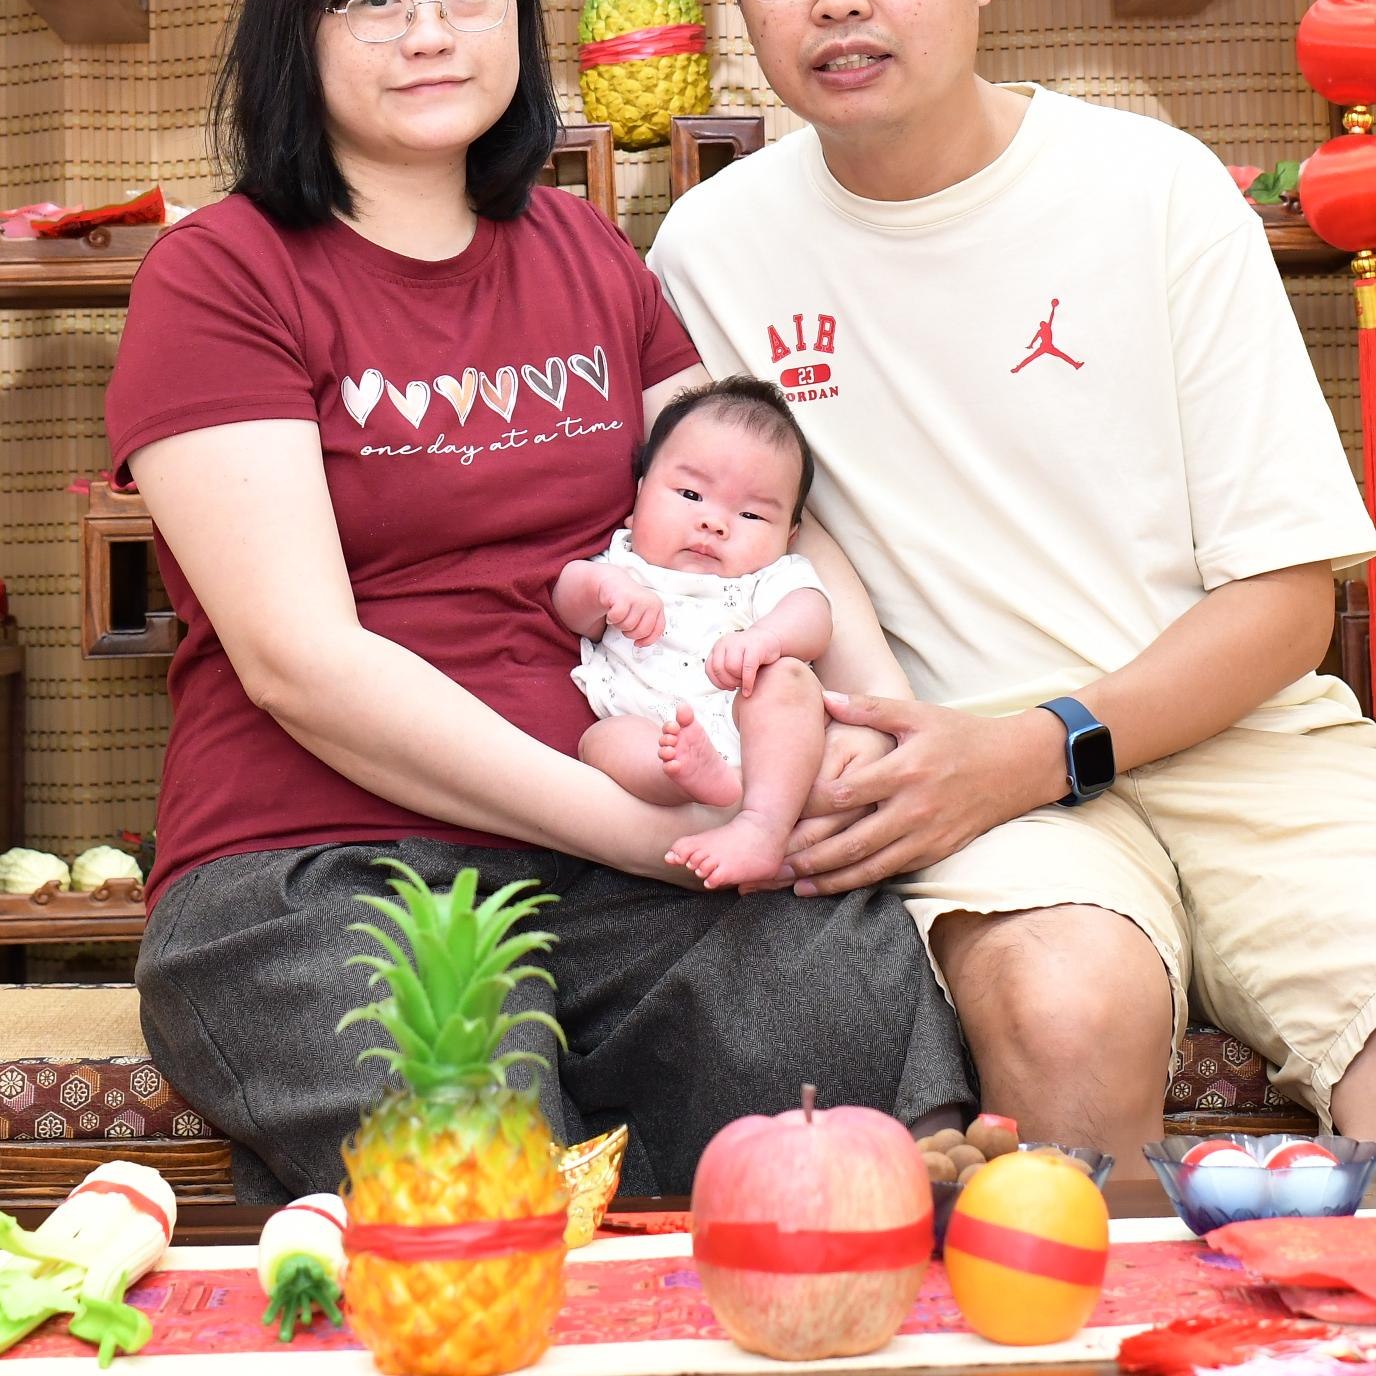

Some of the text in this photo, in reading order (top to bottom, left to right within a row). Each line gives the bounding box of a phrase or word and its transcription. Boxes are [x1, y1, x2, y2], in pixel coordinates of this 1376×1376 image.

[767, 313, 837, 364] AIR
[796, 366, 815, 385] 23
[784, 385, 839, 403] ORDAN
[360, 416, 624, 466] one day at a time
